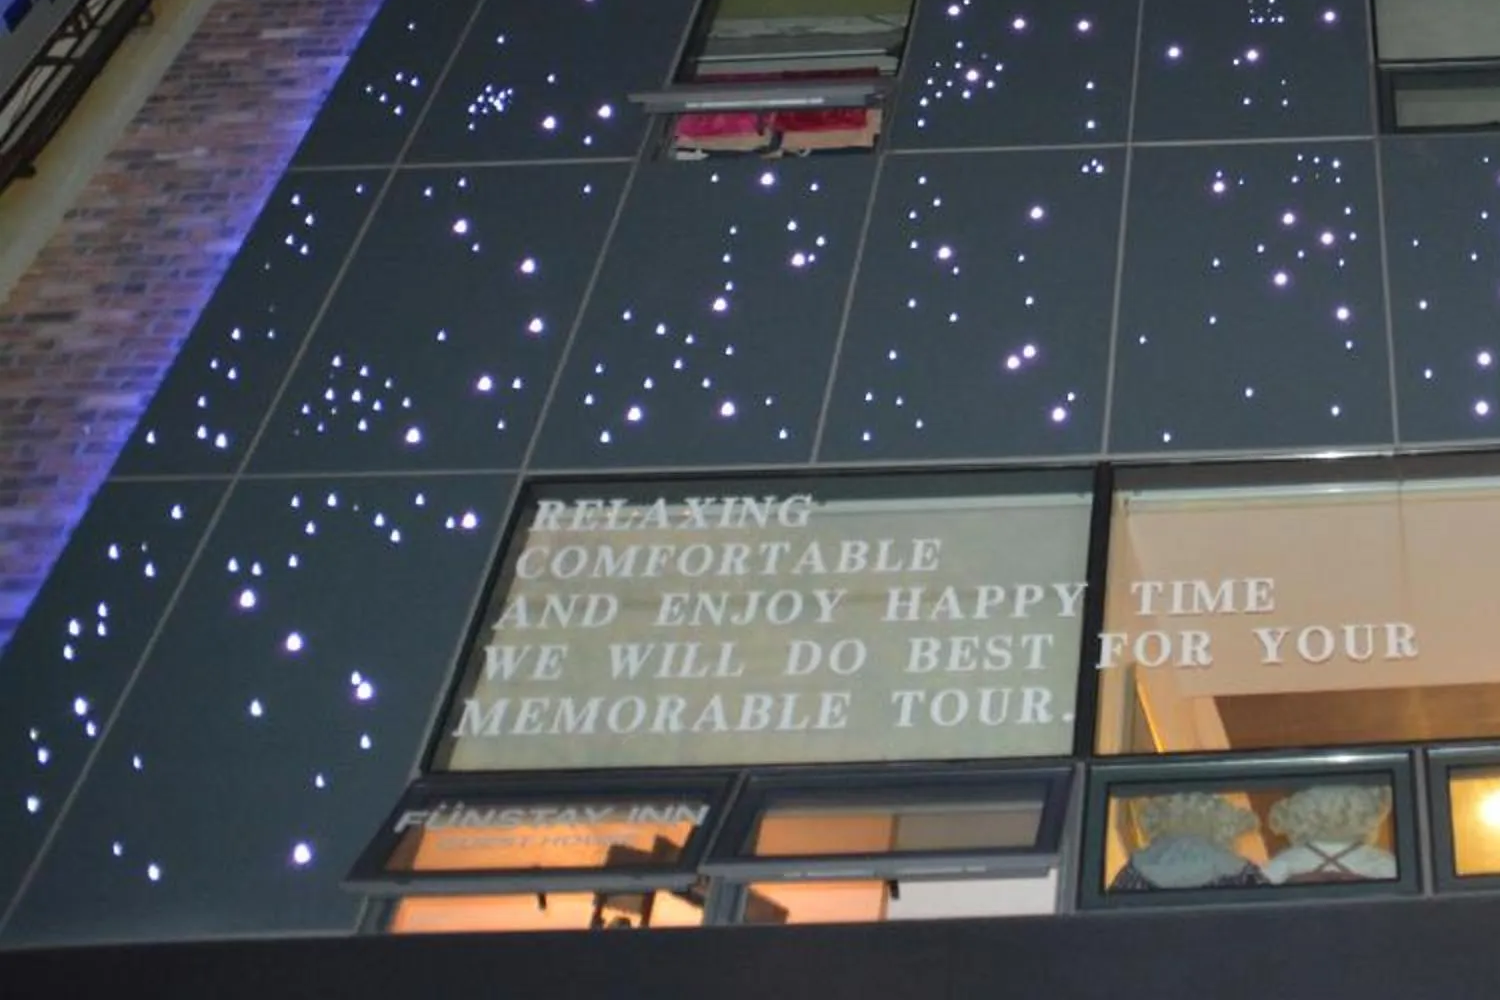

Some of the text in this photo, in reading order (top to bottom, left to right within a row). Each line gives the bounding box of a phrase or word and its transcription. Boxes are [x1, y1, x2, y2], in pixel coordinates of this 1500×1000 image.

[528, 493, 813, 532] RELAXING
[515, 538, 942, 580] COMFORTABLE
[492, 576, 1276, 631] AND ENJOY HAPPY TIME
[482, 620, 1420, 682] WE WILL DO BEST FOR YOUR
[451, 685, 1076, 739] MEMORABLE TOUR.
[627, 803, 710, 828] INN
